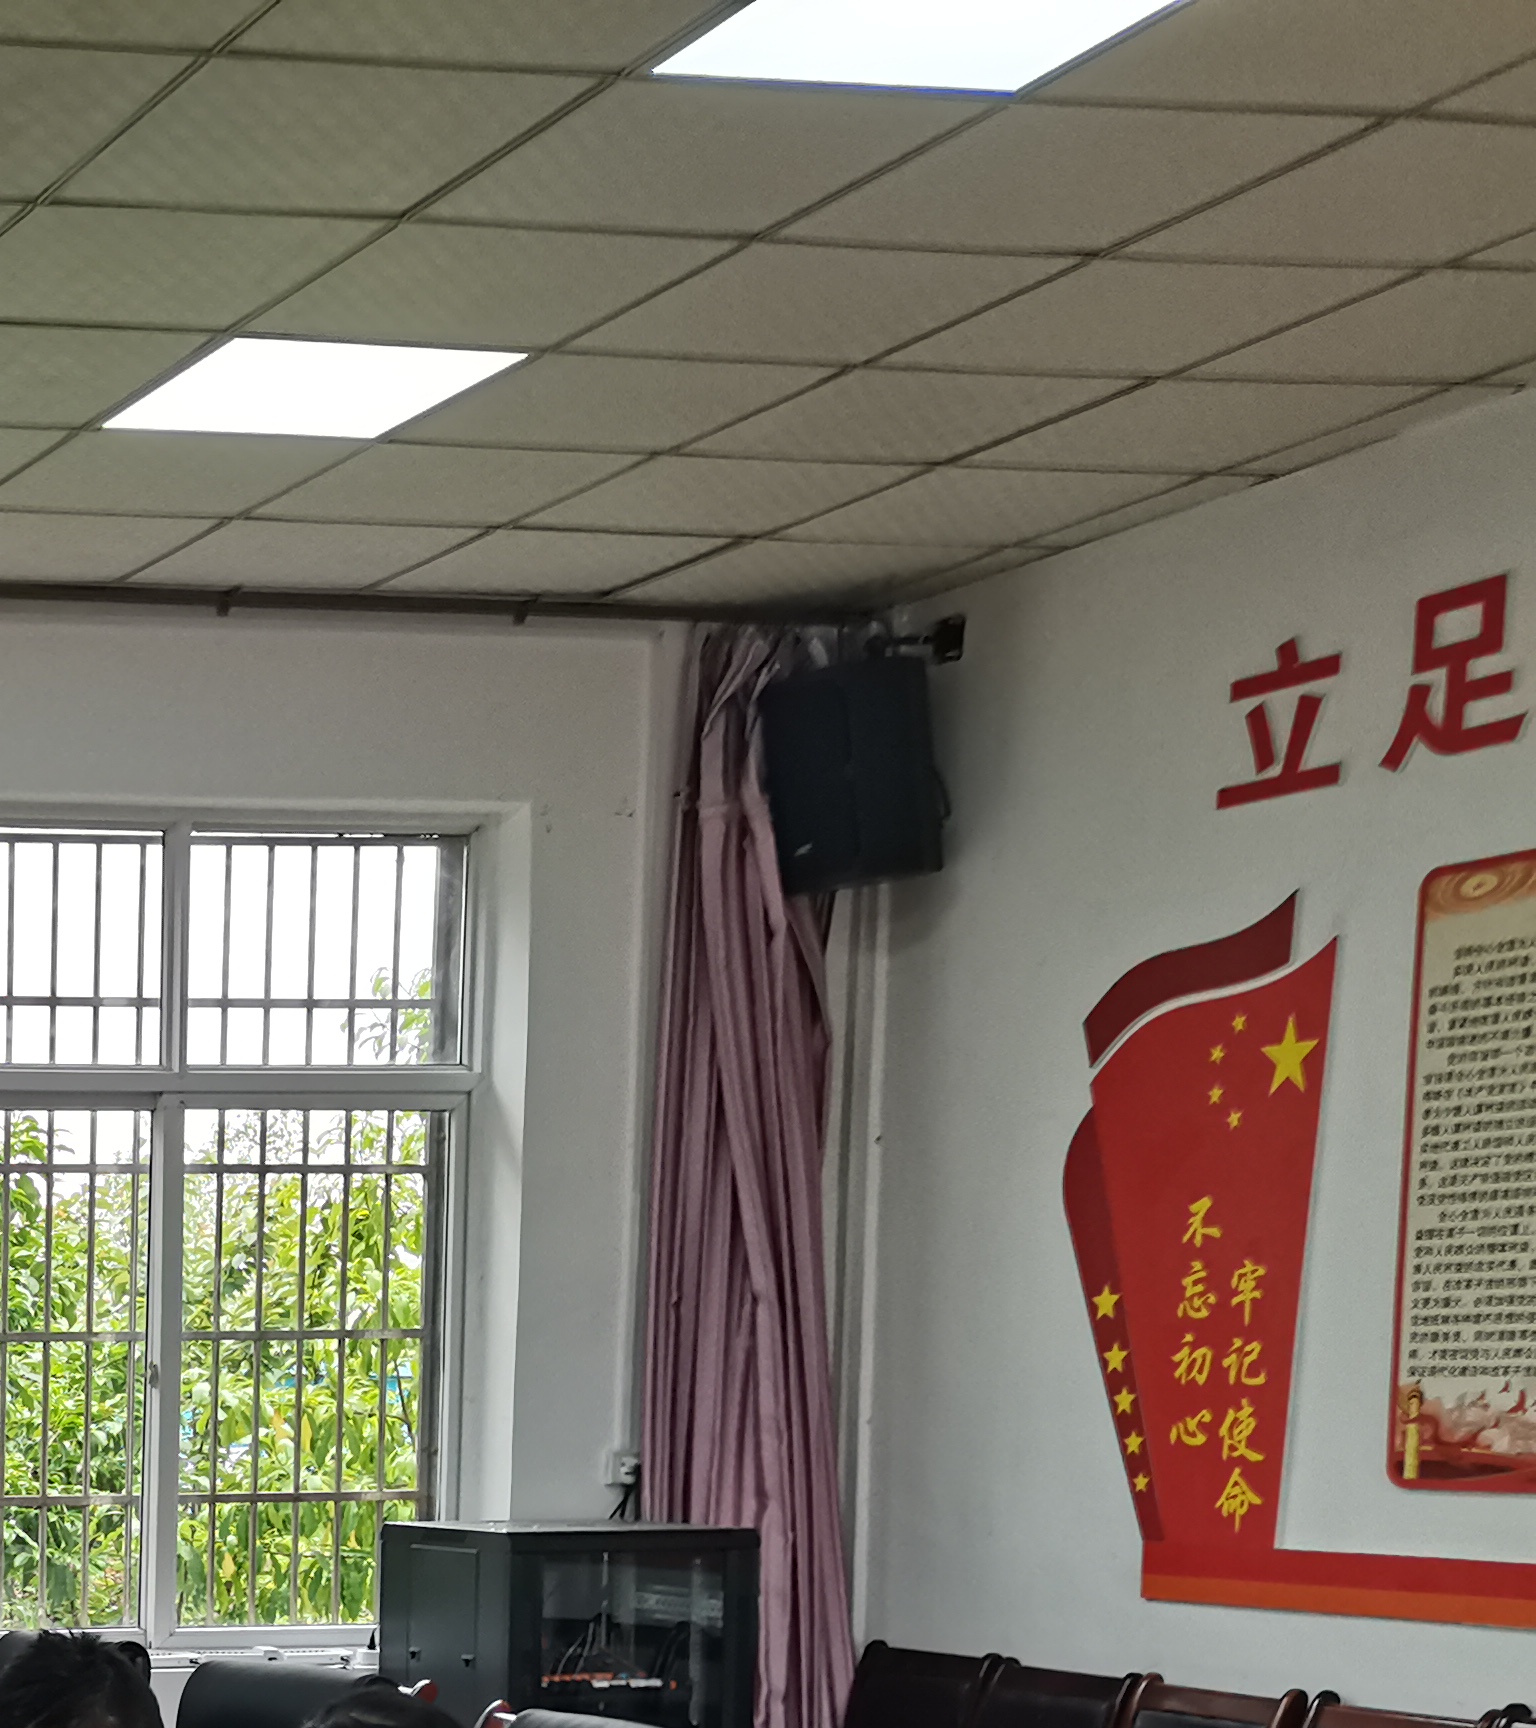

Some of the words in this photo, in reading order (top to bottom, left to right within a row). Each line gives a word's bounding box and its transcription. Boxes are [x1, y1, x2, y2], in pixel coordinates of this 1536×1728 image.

[1215, 572, 1529, 811] 立足
[1170, 1196, 1223, 1447] 不忘初心
[1215, 1259, 1268, 1515] 牢记使命
